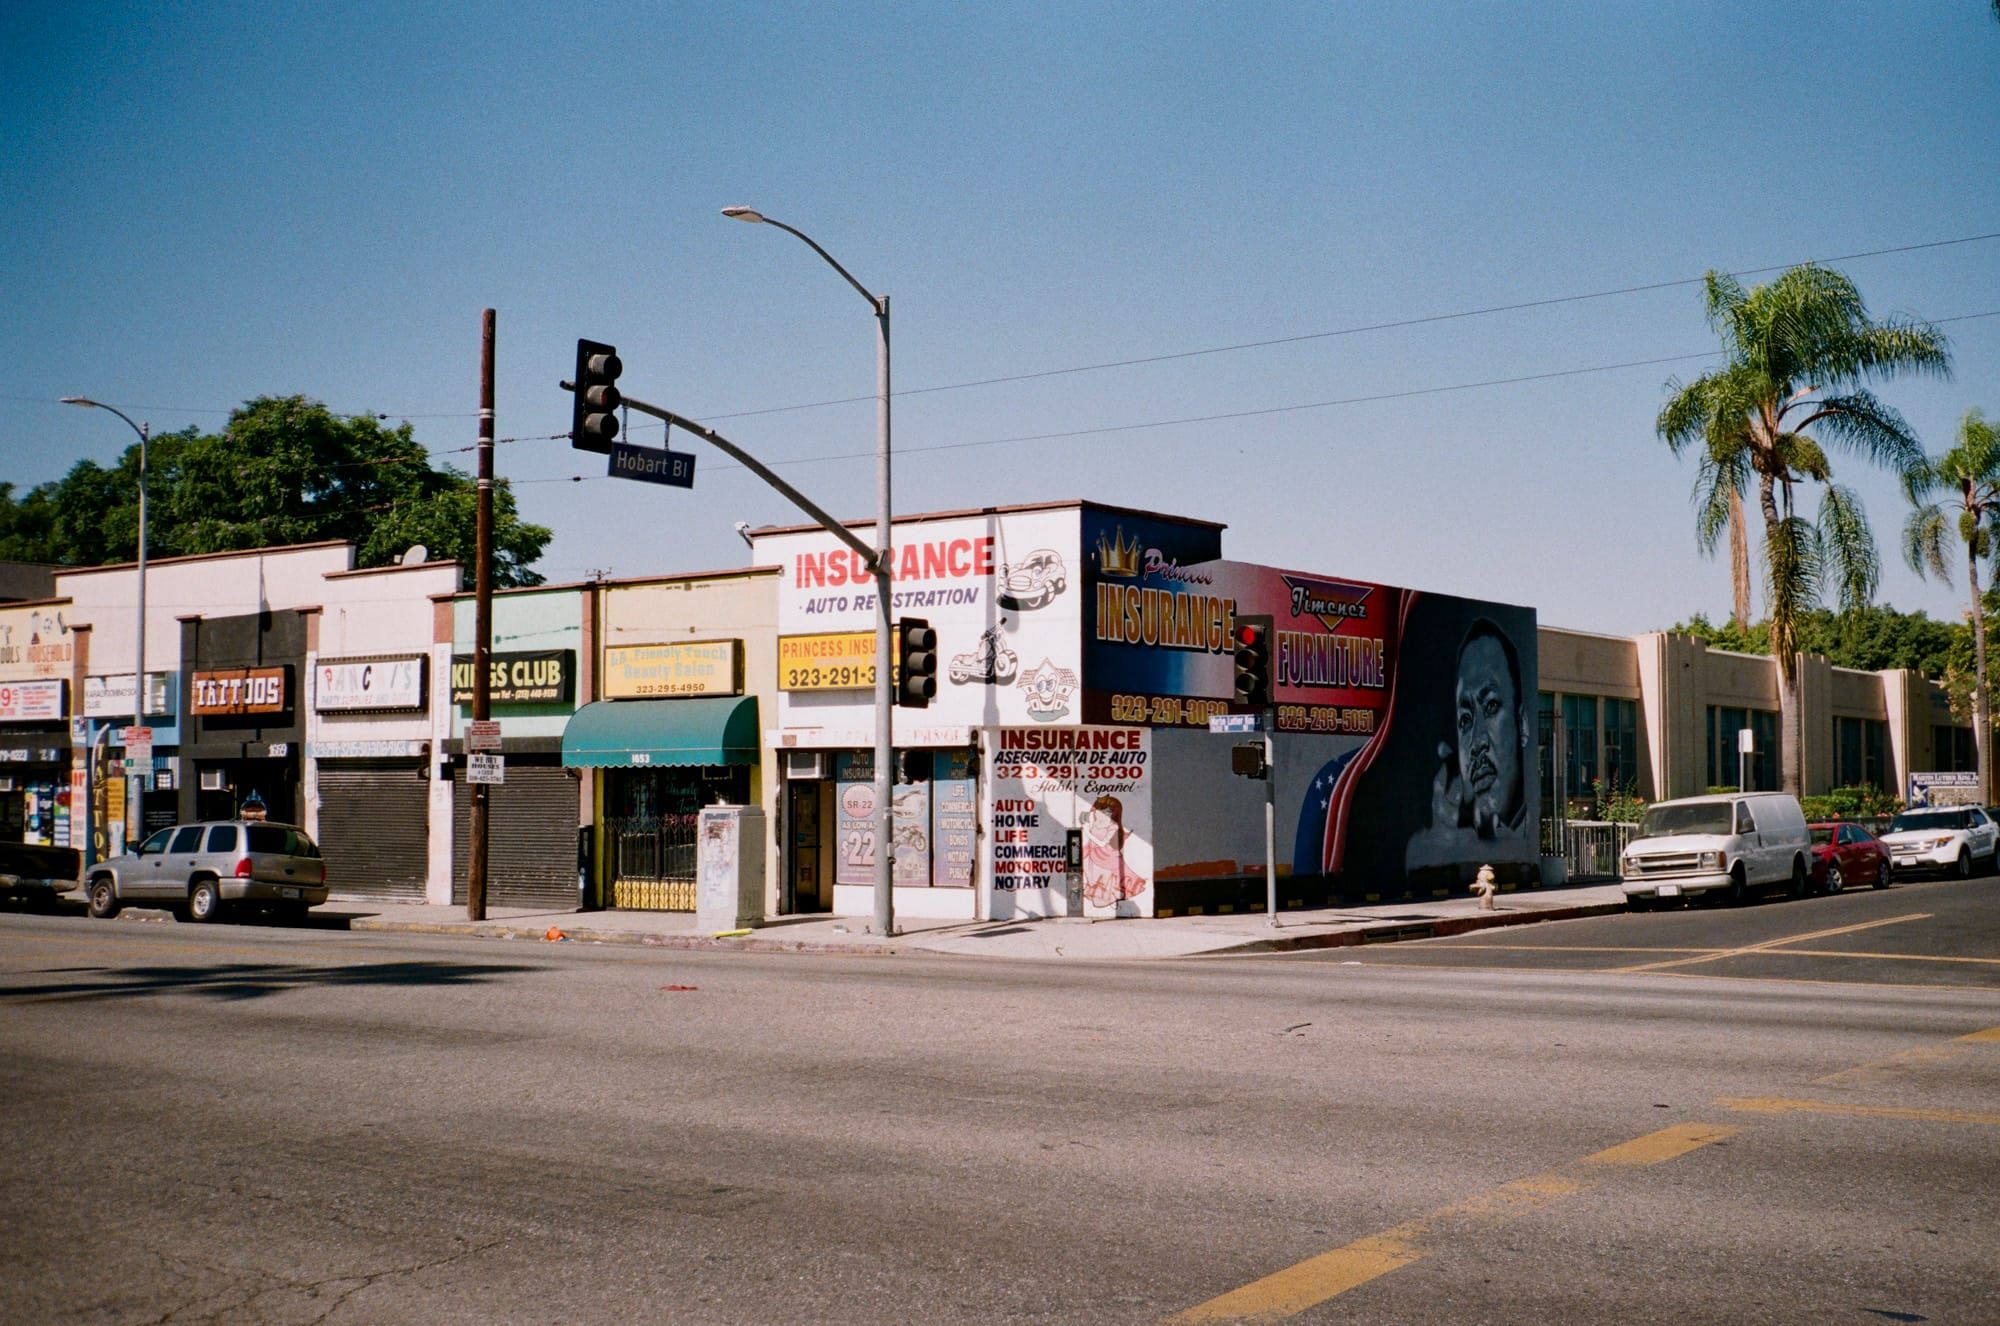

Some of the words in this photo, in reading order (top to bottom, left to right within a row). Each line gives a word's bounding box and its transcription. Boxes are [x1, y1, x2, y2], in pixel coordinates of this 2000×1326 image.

[617, 451, 668, 475] Hobart
[673, 460, 687, 478] Bl
[806, 594, 847, 614] AUTO
[853, 587, 979, 611] RESTRATION
[1292, 587, 1367, 618] Jimenez
[1096, 582, 1236, 651] INSURANCE
[634, 646, 681, 661] Friendly
[684, 645, 728, 660] Touch
[783, 640, 843, 657] PRINCESS
[1276, 630, 1384, 688] FURNITURE
[451, 662, 508, 688] KIS
[511, 660, 561, 686] CLUB
[624, 663, 671, 681] Beauty
[675, 662, 715, 677] Salon
[789, 665, 900, 687] 323-291-33
[196, 677, 280, 706] TATTOOS
[636, 683, 705, 694] 323-295-4950
[1278, 706, 1374, 732] 323-293-5051
[1001, 730, 1141, 750] INSURANCE
[852, 753, 869, 764] AUTO
[1089, 752, 1106, 764] DE
[1108, 751, 1147, 764] AUTO
[842, 767, 875, 779] INSURANC
[952, 785, 964, 797] LIFE
[1083, 780, 1136, 794] Español
[847, 800, 873, 809] SR-22
[994, 799, 1035, 812] AUTO
[852, 821, 867, 830] LOW
[940, 818, 977, 830] MOTORCYCL
[995, 815, 1039, 828] HOME
[995, 830, 1028, 843] LIFE
[995, 845, 1067, 858] COMMERCIA
[995, 860, 1067, 873] MOTORCYC
[994, 876, 1050, 890] NOTARY
